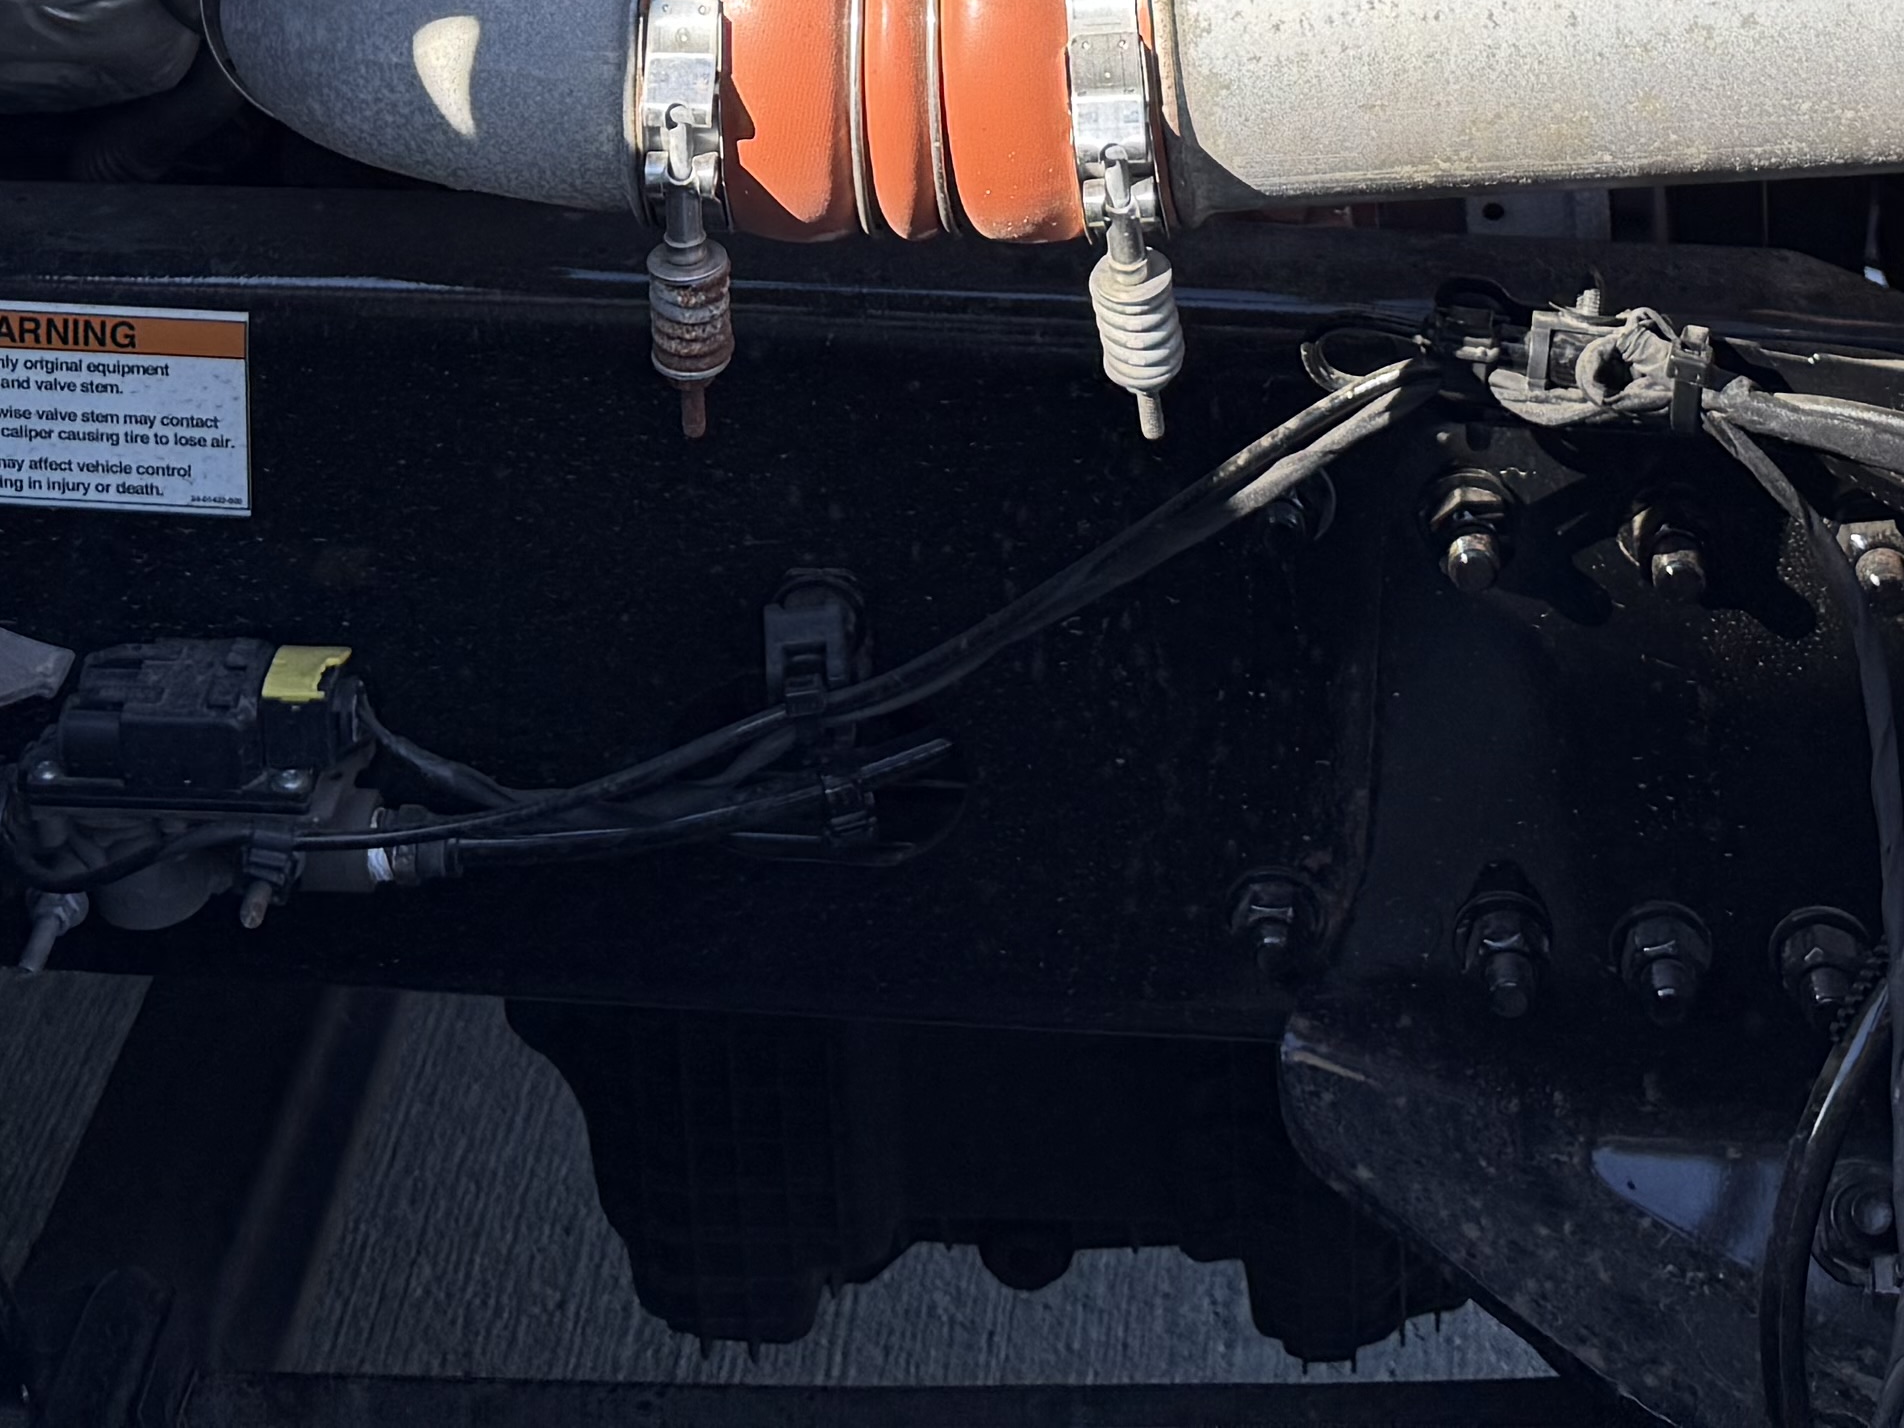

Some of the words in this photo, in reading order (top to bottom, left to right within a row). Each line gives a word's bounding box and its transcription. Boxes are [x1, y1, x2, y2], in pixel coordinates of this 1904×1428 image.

[23, 356, 83, 376] original
[86, 360, 170, 380] equipment
[0, 376, 31, 392] and
[34, 378, 78, 393] valve
[81, 380, 124, 396] stem.
[35, 406, 78, 422] valve
[80, 408, 120, 425] stem
[122, 411, 158, 430] may
[160, 413, 220, 430] contact
[1, 423, 54, 443] caliper
[57, 427, 121, 447] causing
[123, 430, 150, 445] tire
[153, 431, 170, 446] to
[173, 432, 207, 447] lose
[211, 434, 236, 449] air.
[29, 456, 74, 474] affect
[77, 459, 134, 475] vehicle
[136, 462, 192, 479] control
[27, 475, 43, 490] in
[45, 477, 91, 496] injury
[94, 481, 113, 494] or
[115, 481, 164, 497] death.
